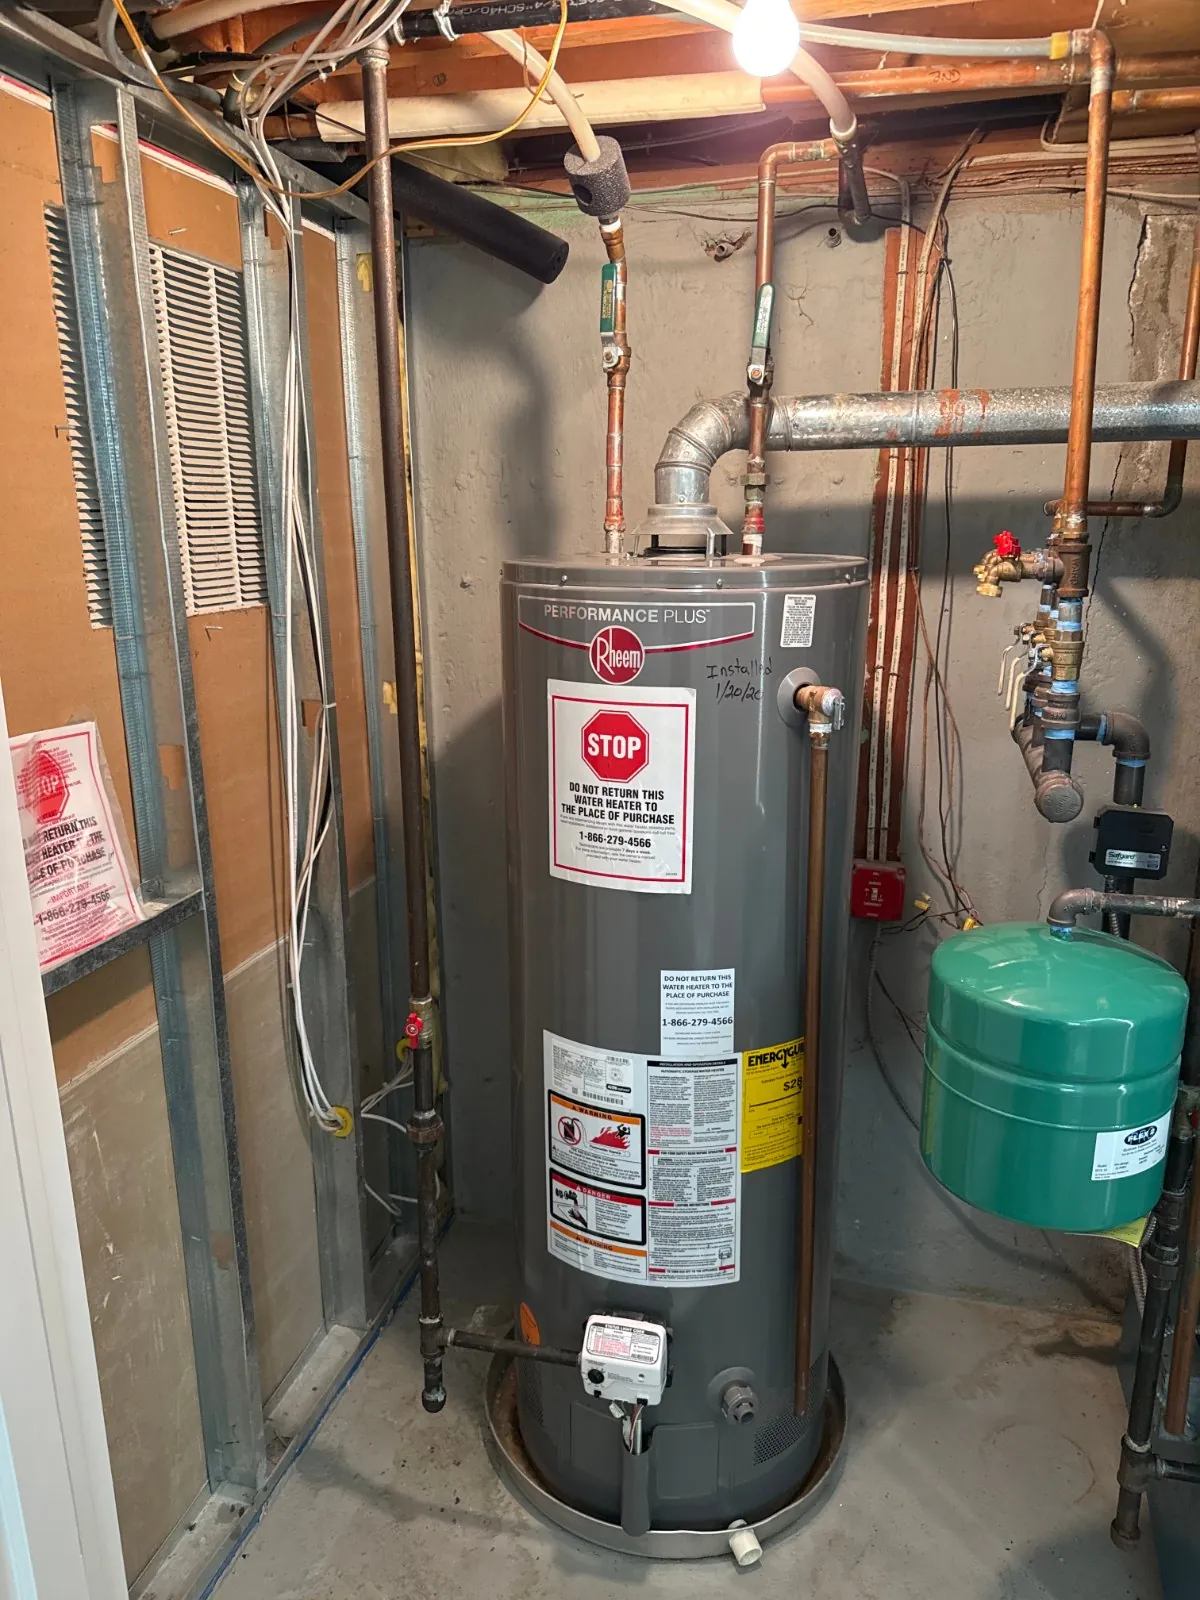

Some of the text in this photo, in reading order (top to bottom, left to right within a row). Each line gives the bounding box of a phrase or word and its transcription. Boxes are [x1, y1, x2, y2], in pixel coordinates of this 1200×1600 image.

[544, 603, 658, 623] PERFORMANCE
[596, 628, 641, 676] Rheem
[587, 733, 641, 760] STOP
[569, 781, 665, 801] DO NOT RETURN THIS
[574, 794, 658, 812] WATER HEATER TO
[561, 802, 576, 815] THE
[579, 806, 605, 820] PLACE
[608, 810, 620, 821] OF
[623, 812, 675, 825] PURCHASE
[43, 820, 78, 842] RETURN
[79, 816, 98, 830] THIS
[579, 831, 651, 848] 1-866-279-4566
[41, 839, 75, 860] HEATER
[47, 864, 59, 876] OF
[662, 1016, 733, 1027] 1-866-279-4566
[579, 1107, 612, 1120] WARNING
[583, 1188, 611, 1200] DANGER
[584, 1237, 613, 1250] WARNING
